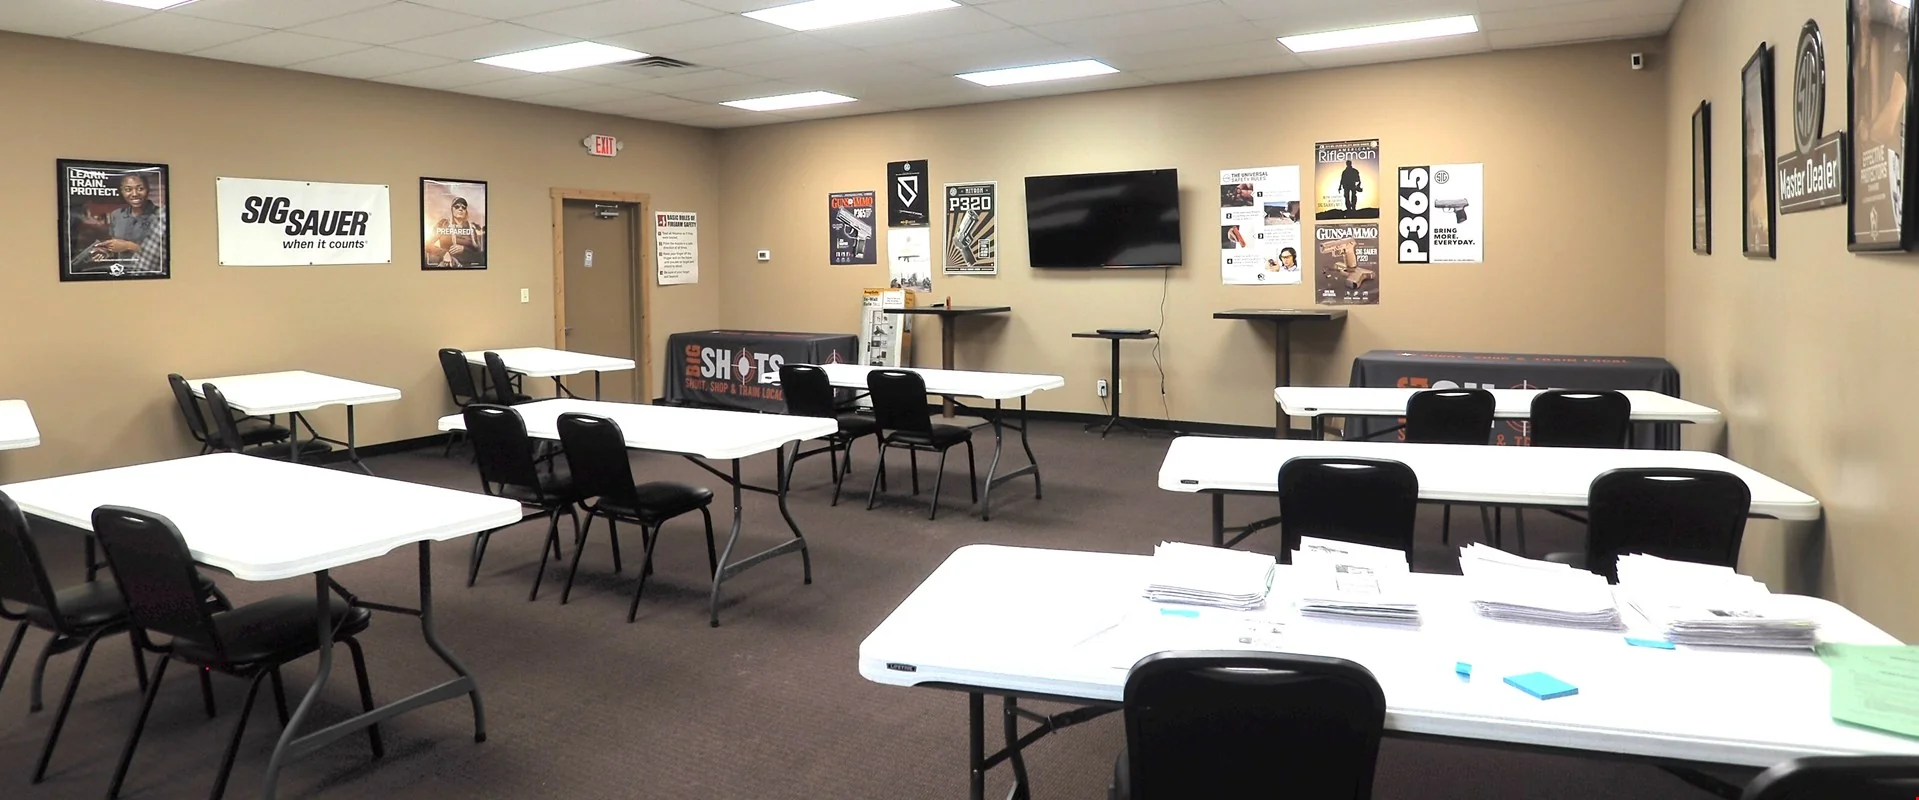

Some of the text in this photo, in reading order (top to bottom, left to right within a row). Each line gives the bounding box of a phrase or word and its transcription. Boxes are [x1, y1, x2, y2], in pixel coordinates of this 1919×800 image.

[595, 136, 614, 155] EXIT
[1318, 150, 1376, 162] Rifleman
[70, 170, 108, 180] LEARN.
[70, 178, 106, 188] TRAIN.
[1780, 153, 1837, 200] Master Dealer
[70, 187, 120, 196] PROTECT.
[241, 196, 290, 224] SIG
[950, 196, 991, 211] P320
[285, 209, 369, 236] SAUER
[1399, 167, 1428, 262] P365
[282, 239, 365, 249] when it counts
[685, 344, 701, 378] BIG
[710, 381, 728, 392] SHOP
[730, 383, 737, 394] &
[739, 384, 760, 398] TRAIN
[762, 387, 784, 400] LOCAL
